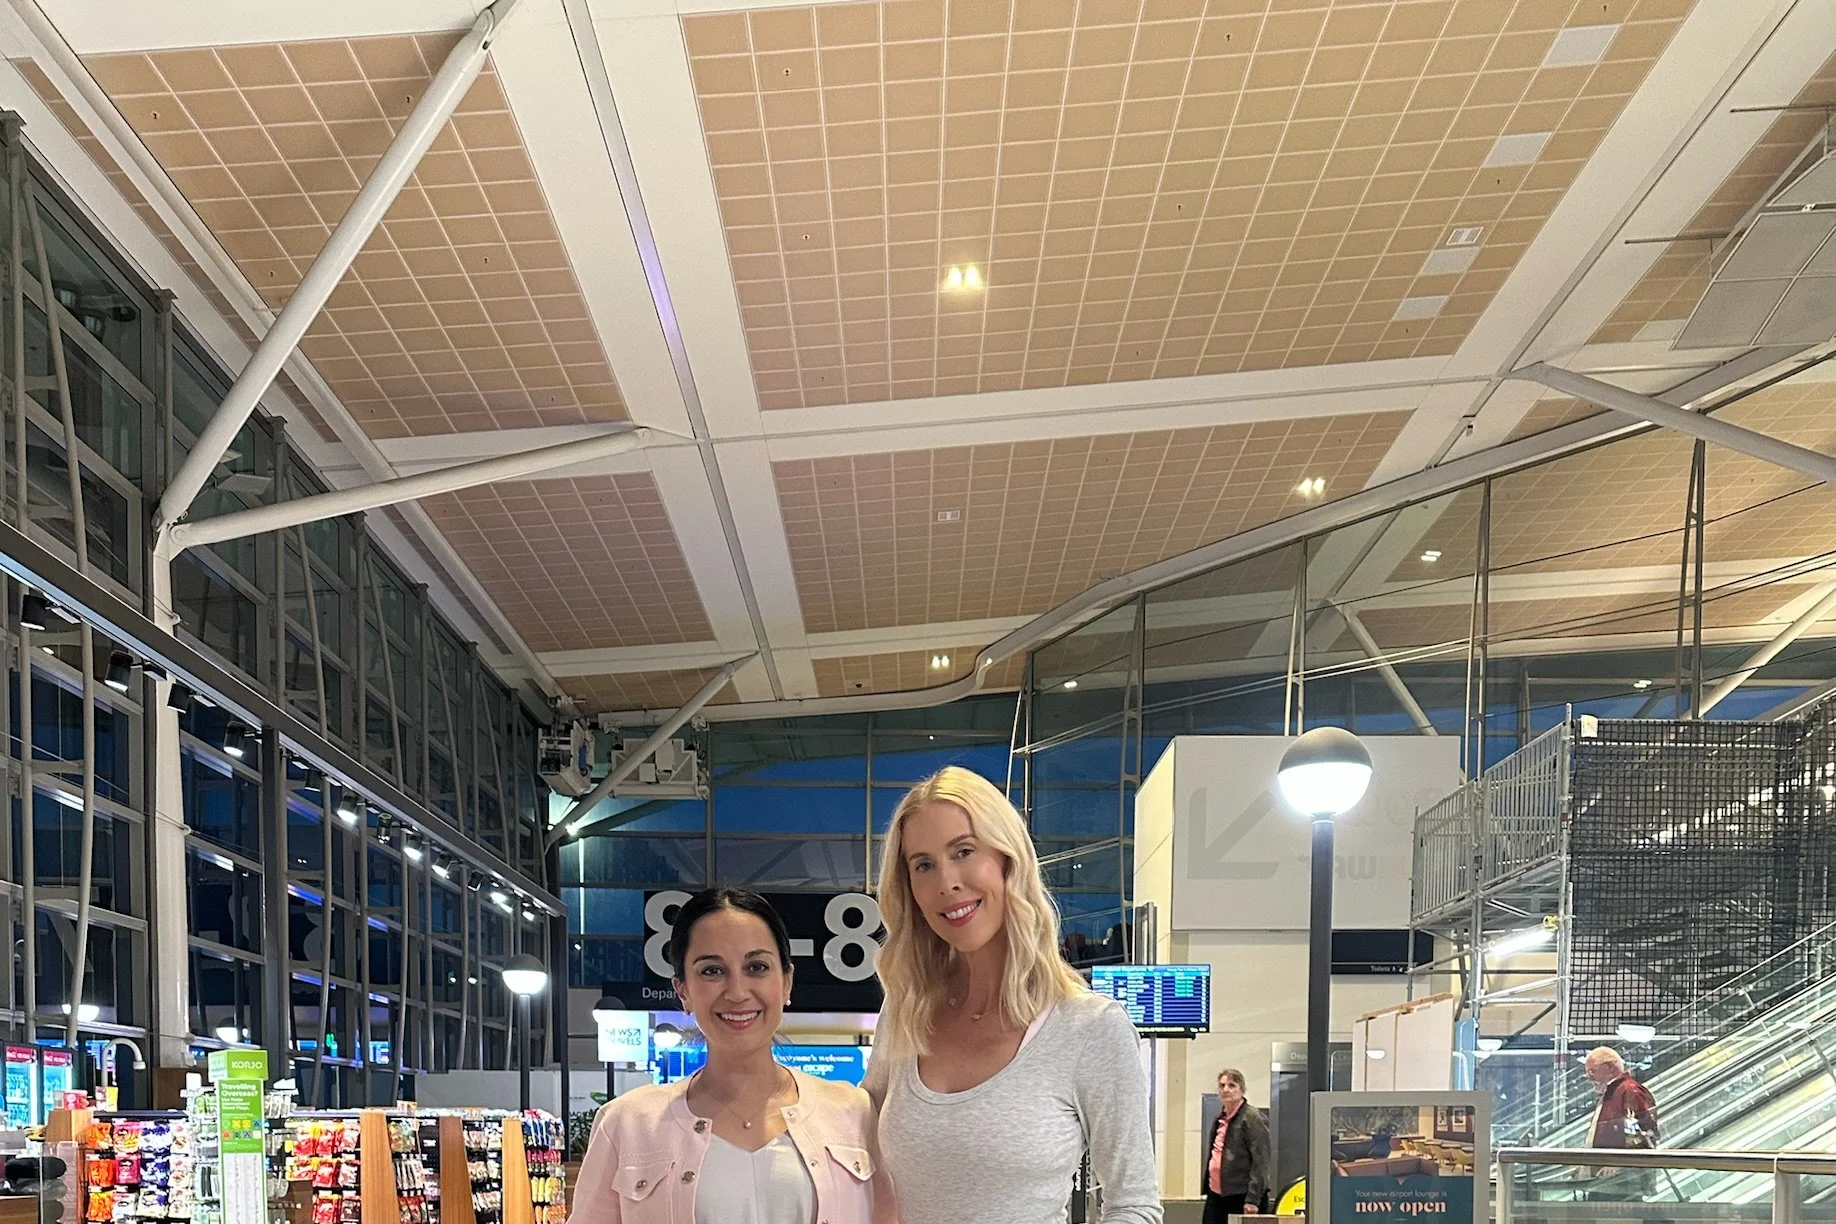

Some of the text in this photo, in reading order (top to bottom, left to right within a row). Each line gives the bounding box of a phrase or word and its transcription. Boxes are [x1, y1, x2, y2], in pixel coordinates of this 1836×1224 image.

[231, 1060, 263, 1069] KORJO
[221, 1083, 257, 1091] Travelling
[1389, 1190, 1414, 1198] airport
[1415, 1190, 1439, 1199] lounge
[1355, 1202, 1447, 1216] now open
